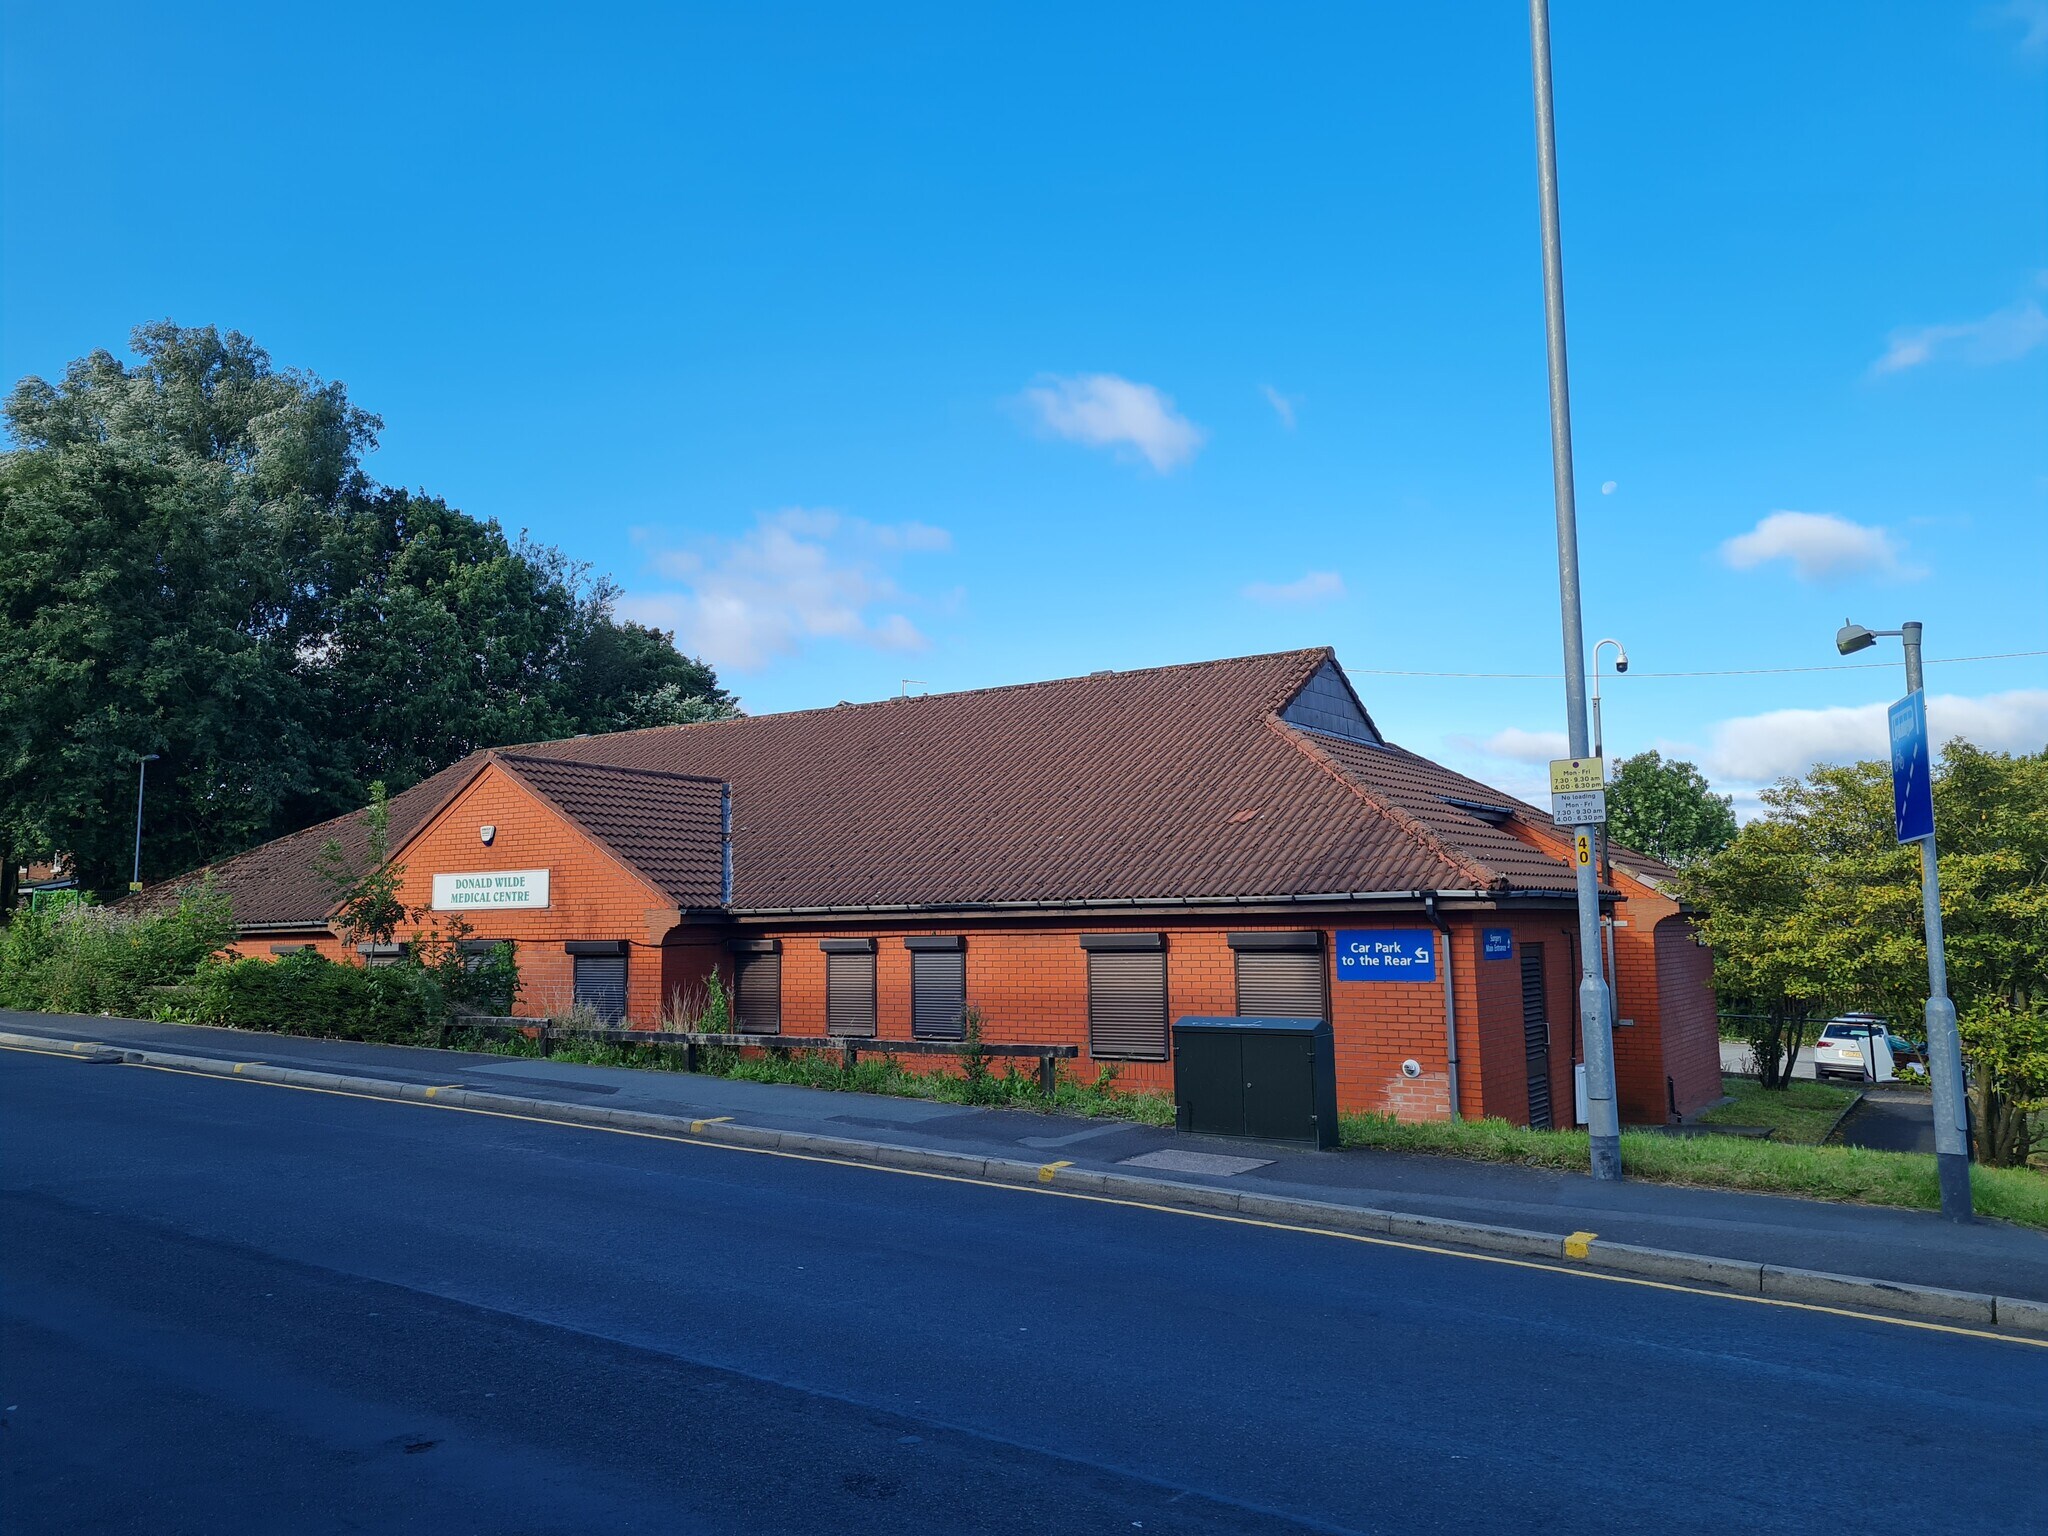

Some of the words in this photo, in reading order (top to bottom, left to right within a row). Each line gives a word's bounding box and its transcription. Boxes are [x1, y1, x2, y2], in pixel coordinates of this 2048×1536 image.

[455, 877, 493, 890] DONALD
[494, 876, 526, 888] WILDE
[450, 892, 491, 904] MEDICAL
[493, 890, 530, 902] CENTRE
[1350, 942, 1370, 953] Car
[1375, 942, 1402, 953] Park
[1342, 956, 1355, 966] to
[1360, 954, 1380, 966] the
[1384, 955, 1412, 966] Rear
